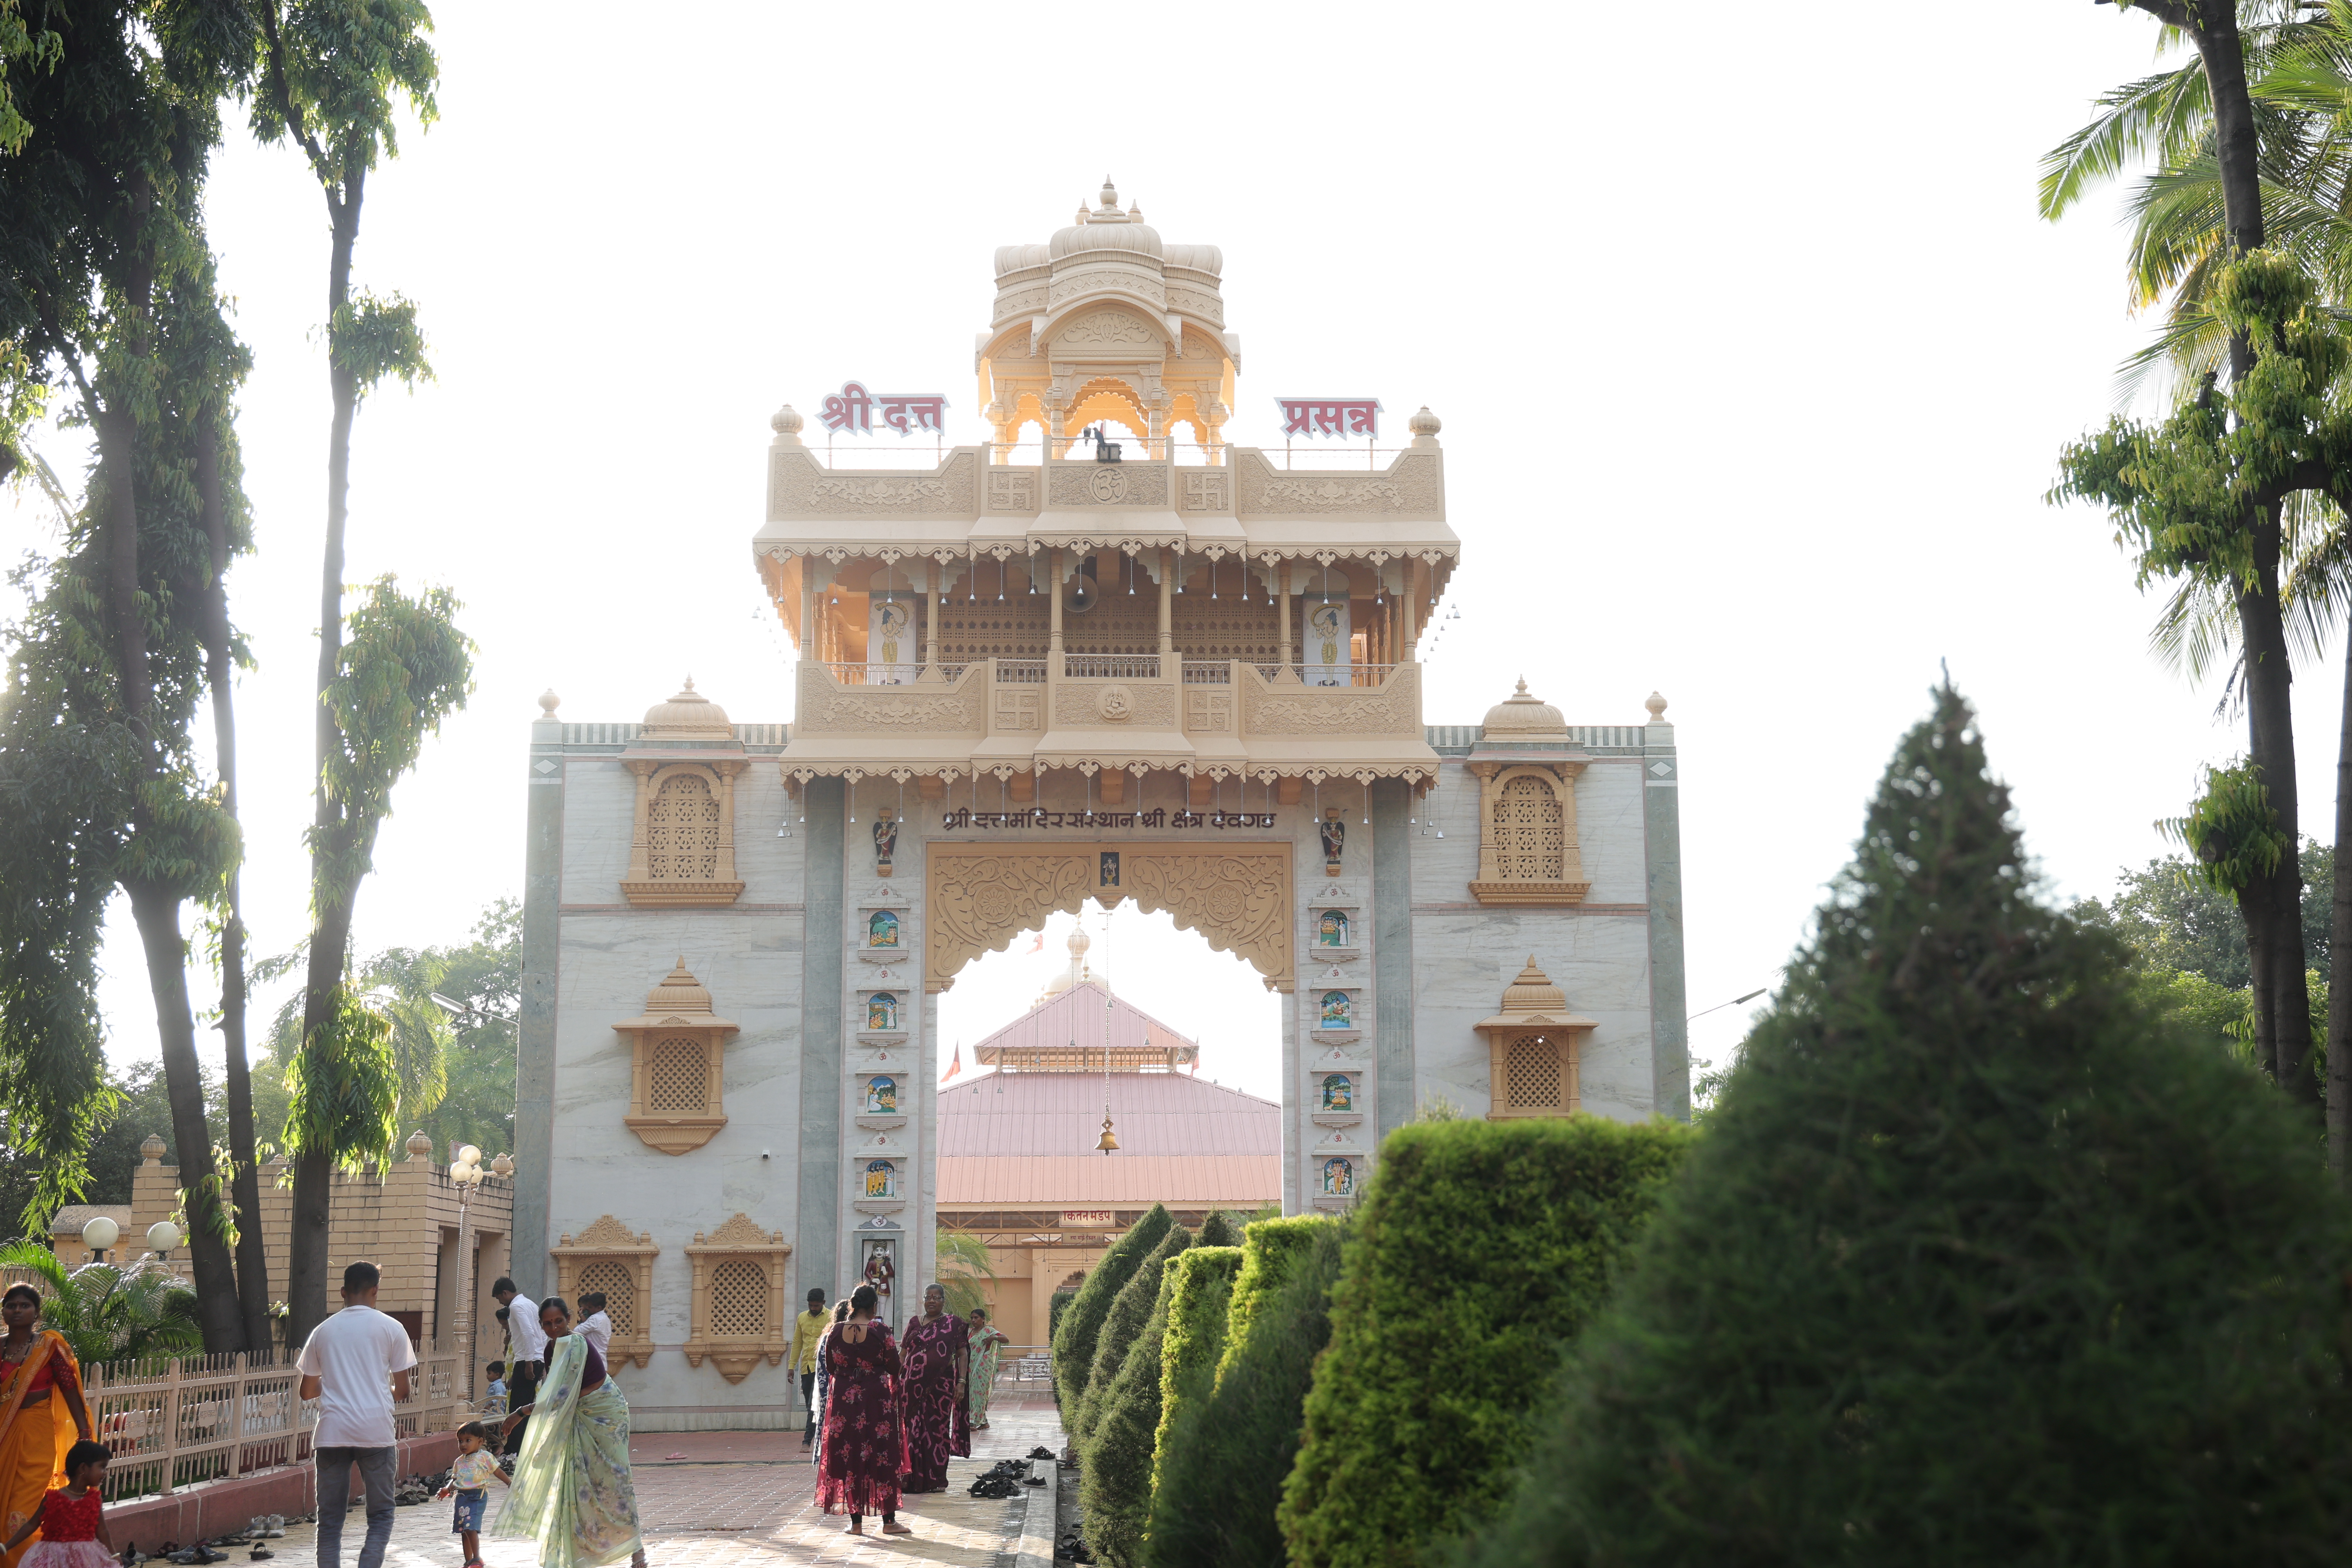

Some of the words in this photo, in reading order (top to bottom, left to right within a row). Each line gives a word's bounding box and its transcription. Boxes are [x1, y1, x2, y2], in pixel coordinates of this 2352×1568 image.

[820, 383, 873, 431] श्री
[878, 397, 946, 434] दत्त
[1279, 401, 1379, 435] प्रसन्न
[943, 806, 971, 831] श्री
[1141, 807, 1166, 828] श्री
[1171, 808, 1206, 829] क्षेत्र
[1209, 809, 1276, 829] देवगड
